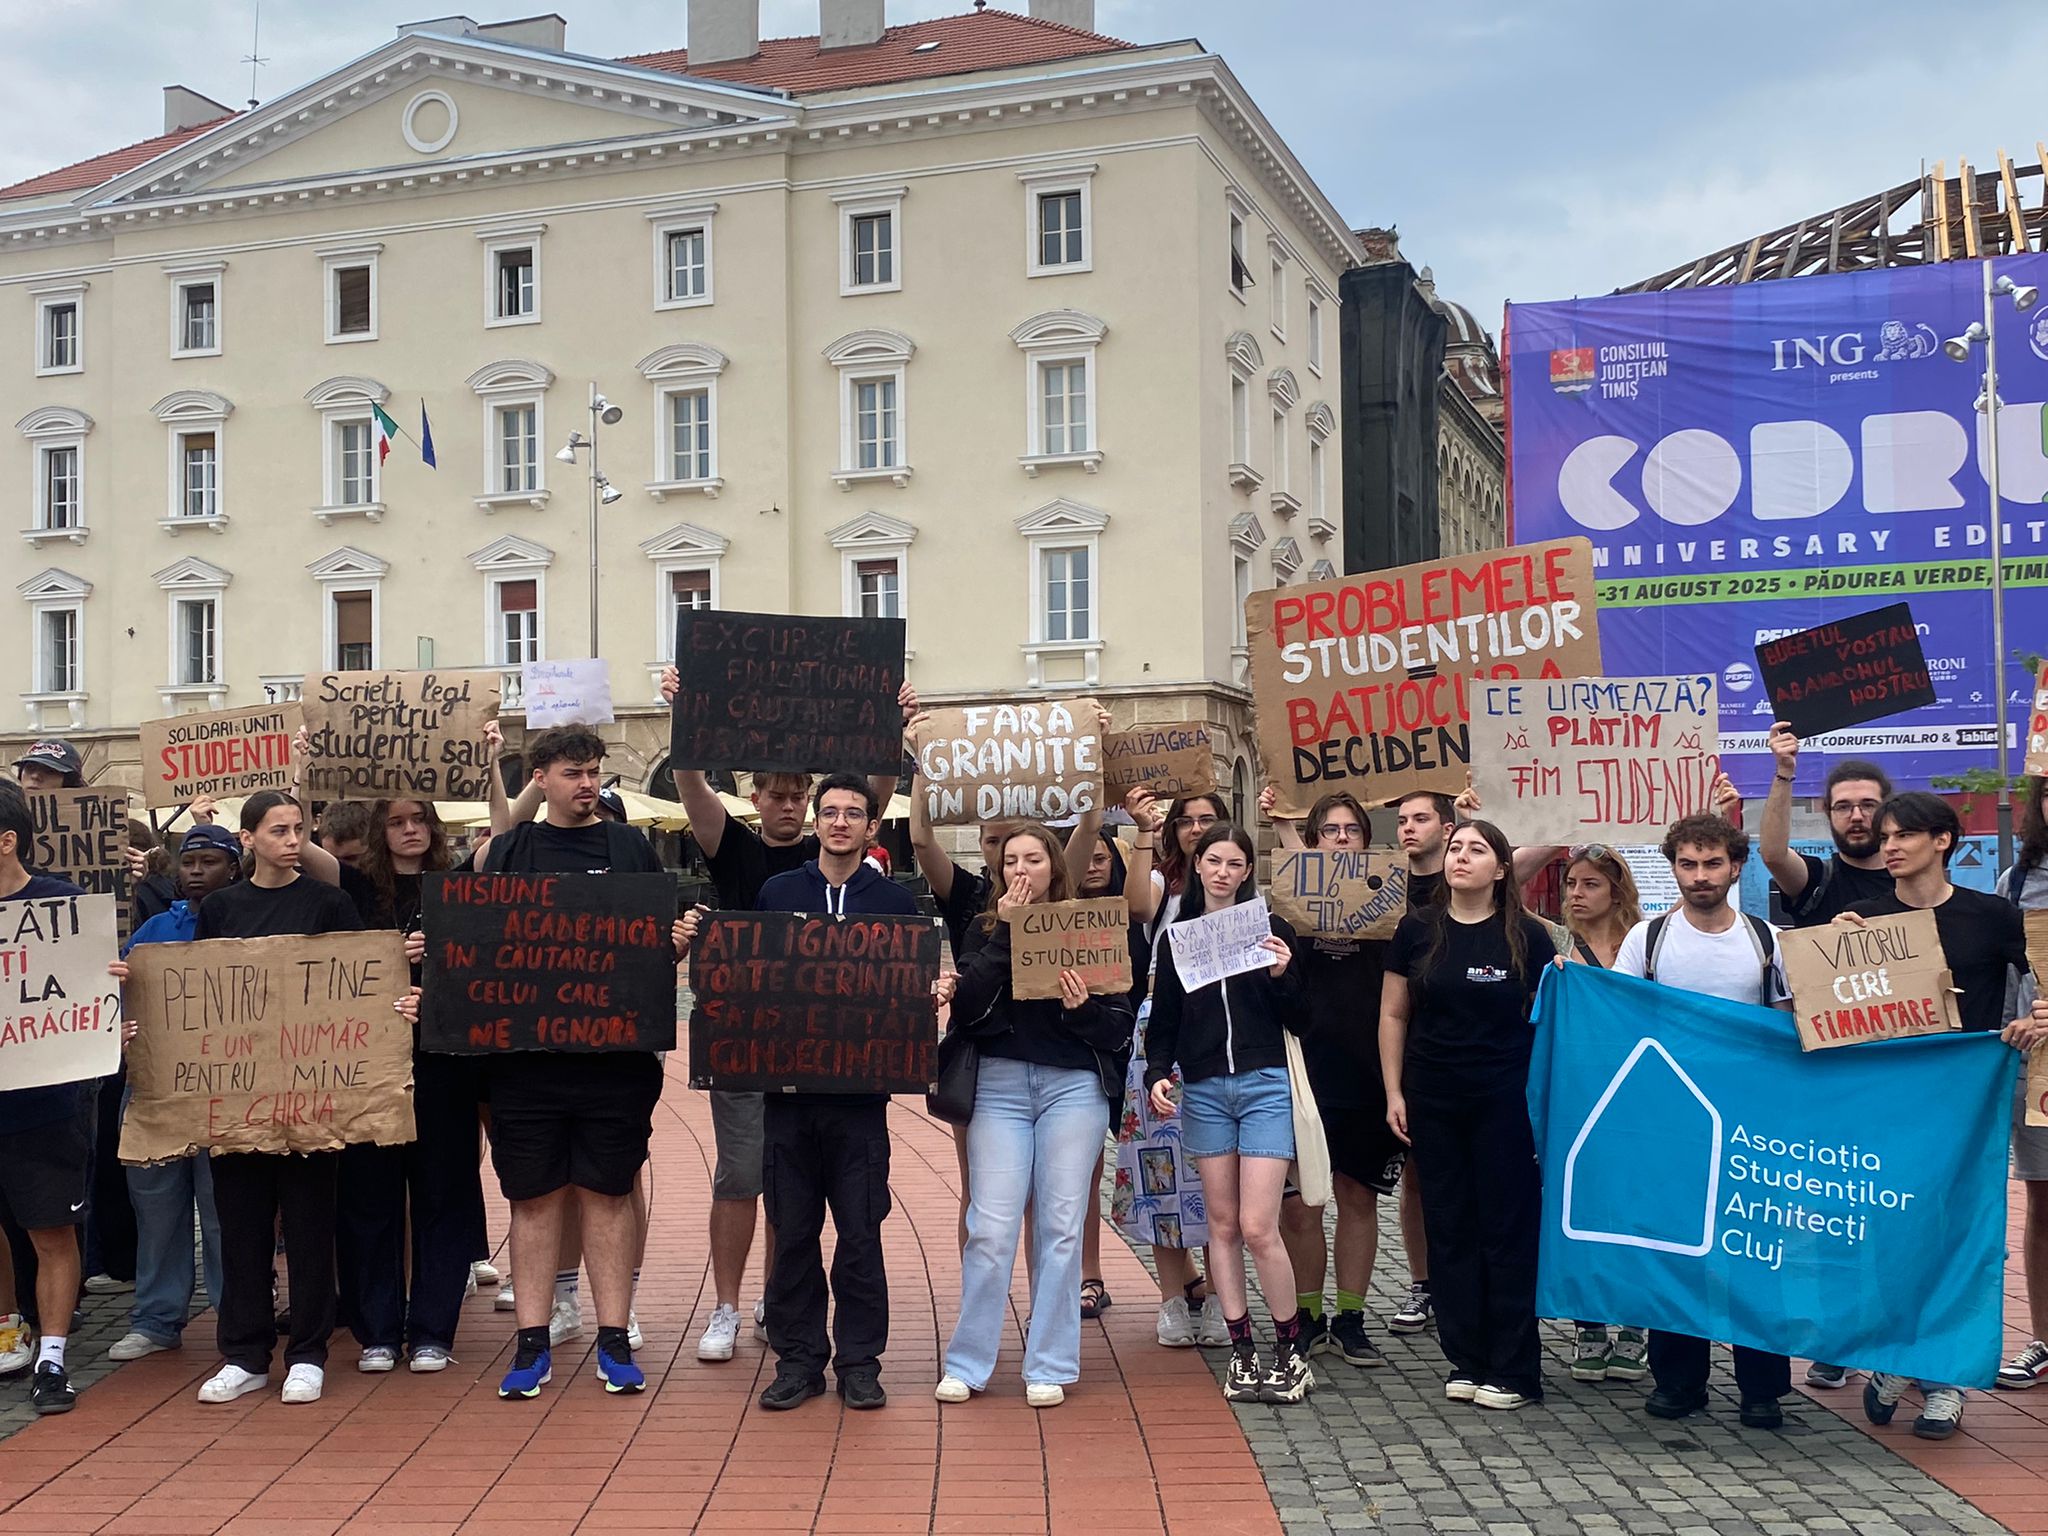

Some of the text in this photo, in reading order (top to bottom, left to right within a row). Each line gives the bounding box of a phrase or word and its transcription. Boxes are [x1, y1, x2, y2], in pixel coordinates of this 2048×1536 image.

[1600, 342, 1669, 363] CONSILIUL
[1771, 333, 1866, 371] ING
[1600, 360, 1667, 384] JUDEȚEAN
[1600, 381, 1639, 400] TIMIȘ
[1829, 369, 1879, 384] presents
[1274, 547, 1575, 648] PROBLEMELE
[1634, 580, 1721, 600] AUGUST
[1727, 577, 1781, 595] 2025
[1804, 568, 1906, 591] PĂDUREA
[1914, 566, 1992, 586] VERDE,
[1281, 600, 1584, 684] STUDENȚILOR
[1835, 625, 1916, 662] VOSTRU
[319, 674, 471, 716] Scrieți legi
[1487, 675, 1713, 716] CE URMEAZĂ?
[1850, 669, 1930, 707] NOSTRU
[168, 722, 233, 745] SOLIDARI
[350, 700, 440, 730] pentru
[1503, 710, 1703, 750] să PLĂTIM să
[308, 721, 490, 770] studenți sau
[1804, 736, 1819, 748] AT
[1821, 732, 1939, 748] CODRUFESTIVAL.RO
[1942, 734, 1951, 743] &
[174, 783, 194, 798] NU
[196, 778, 220, 795] POT
[223, 776, 236, 792] FI
[305, 761, 437, 799] împotriva
[1154, 777, 1192, 795] GOL
[1507, 758, 1562, 799] FIM
[926, 777, 1095, 822] ÎN DIALOG
[442, 876, 559, 907] MISIUNE
[1277, 851, 1380, 898] 10% NET
[1023, 911, 1128, 935] GUVERNUL
[1307, 899, 1344, 934] 90%
[784, 918, 931, 960] IGNORAT
[1021, 944, 1123, 969] STUDENȚII
[20, 975, 66, 1004] LA
[163, 956, 383, 1032] PENTRU TINE
[467, 979, 610, 1007] CELUI CARE
[1832, 968, 1893, 1005] CERE
[201, 1017, 370, 1060] E UN NUMĂR
[469, 1010, 640, 1048] NE IGNORĂ
[174, 1060, 371, 1093] PENTRU MINE
[208, 1089, 335, 1138] E CHIRIA
[1730, 1124, 1881, 1173] Asociația
[1728, 1154, 1915, 1211] Studenților
[1724, 1191, 1866, 1246] Arhitecți
[1721, 1229, 1784, 1271] Cluj
